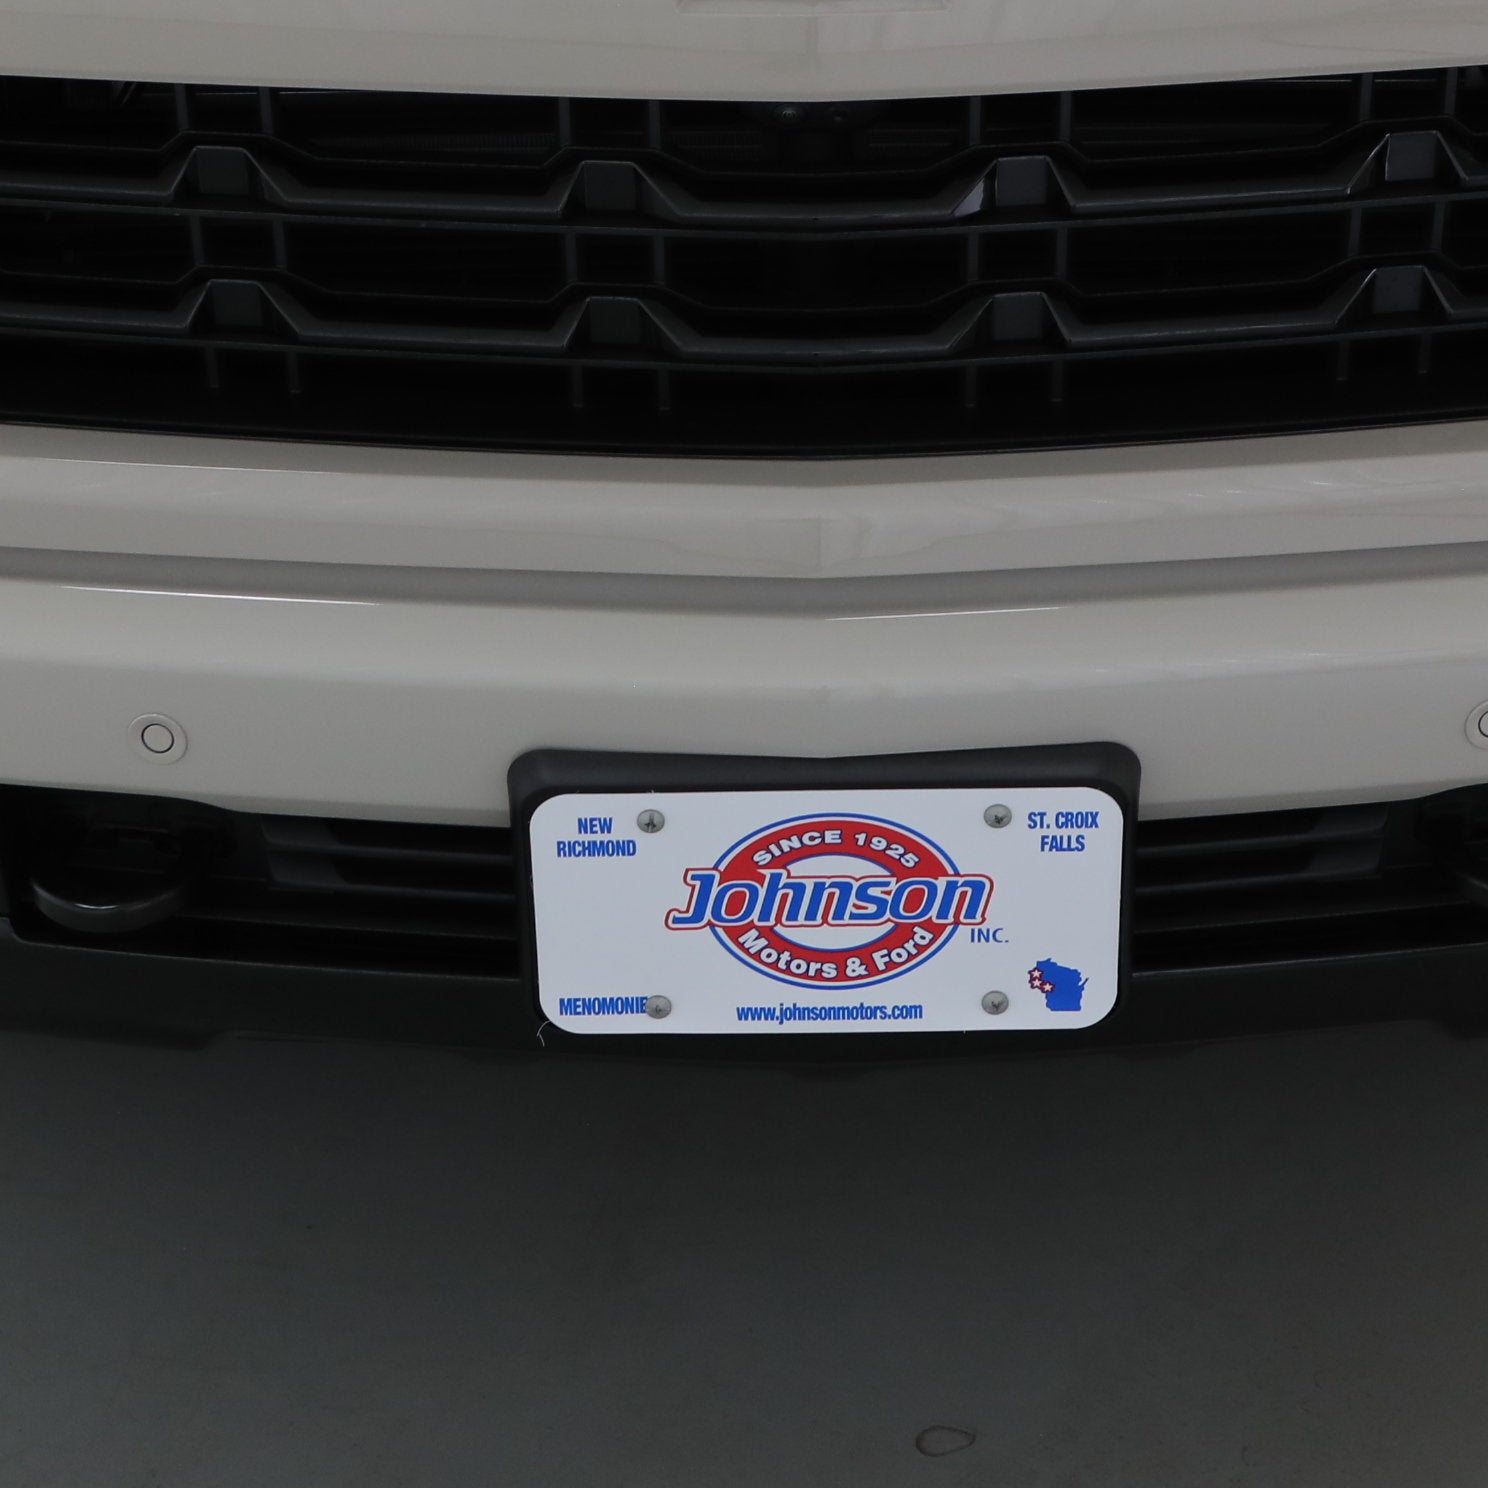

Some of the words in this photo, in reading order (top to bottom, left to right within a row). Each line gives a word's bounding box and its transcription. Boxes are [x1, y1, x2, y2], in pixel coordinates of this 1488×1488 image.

[577, 817, 613, 834] NEW
[1027, 812, 1050, 829] ST.
[1055, 811, 1099, 829] CROIX
[556, 839, 636, 857] RICHMOND
[752, 829, 842, 866] SINCE
[854, 832, 920, 869] 1925
[1040, 834, 1085, 852] FALLS
[669, 870, 989, 926] Johnson
[970, 927, 1009, 943] INC.
[737, 928, 838, 979] Motors
[845, 956, 868, 978] &
[871, 925, 934, 971] Ford
[559, 996, 648, 1016] MENOMONIE
[736, 1002, 923, 1025] www.johnsonmotors.com
